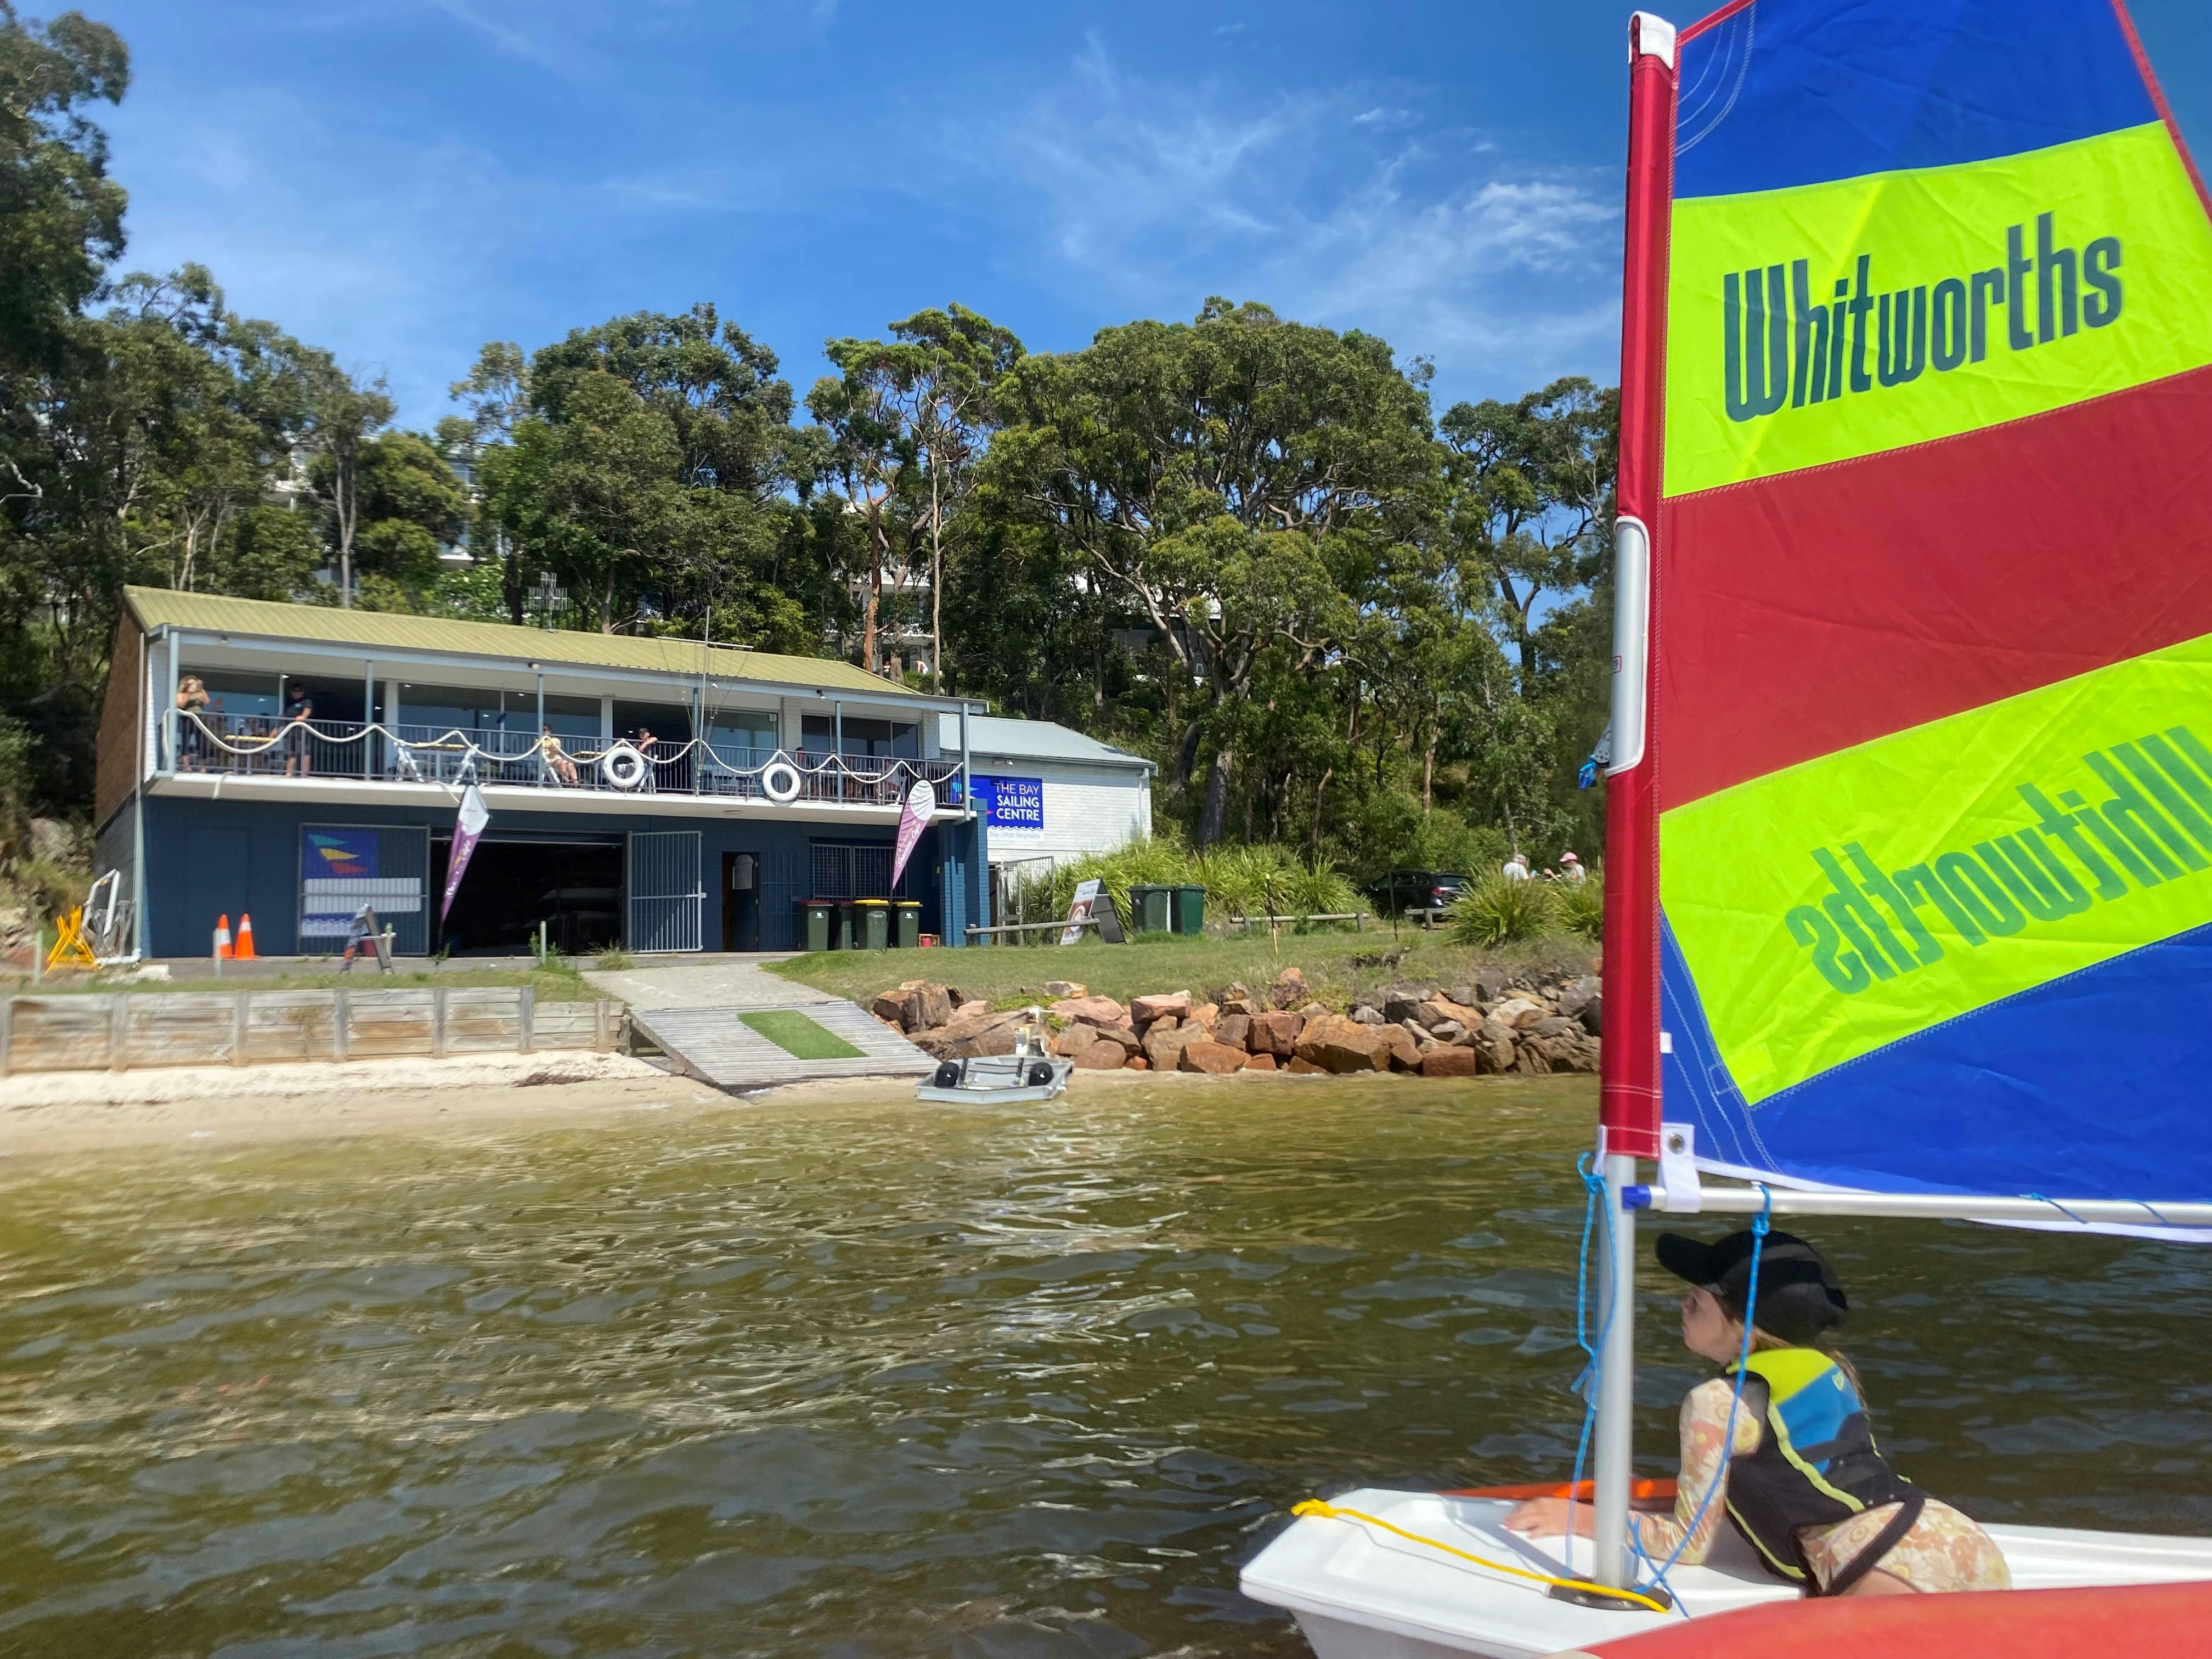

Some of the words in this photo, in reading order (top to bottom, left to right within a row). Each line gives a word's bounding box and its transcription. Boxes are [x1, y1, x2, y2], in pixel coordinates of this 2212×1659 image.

[1724, 211, 2125, 422] Whitworths
[994, 782, 1016, 794] THE
[1019, 784, 1039, 794] BAY
[997, 795, 1039, 808] SAILING
[996, 808, 1040, 821] CENTRE
